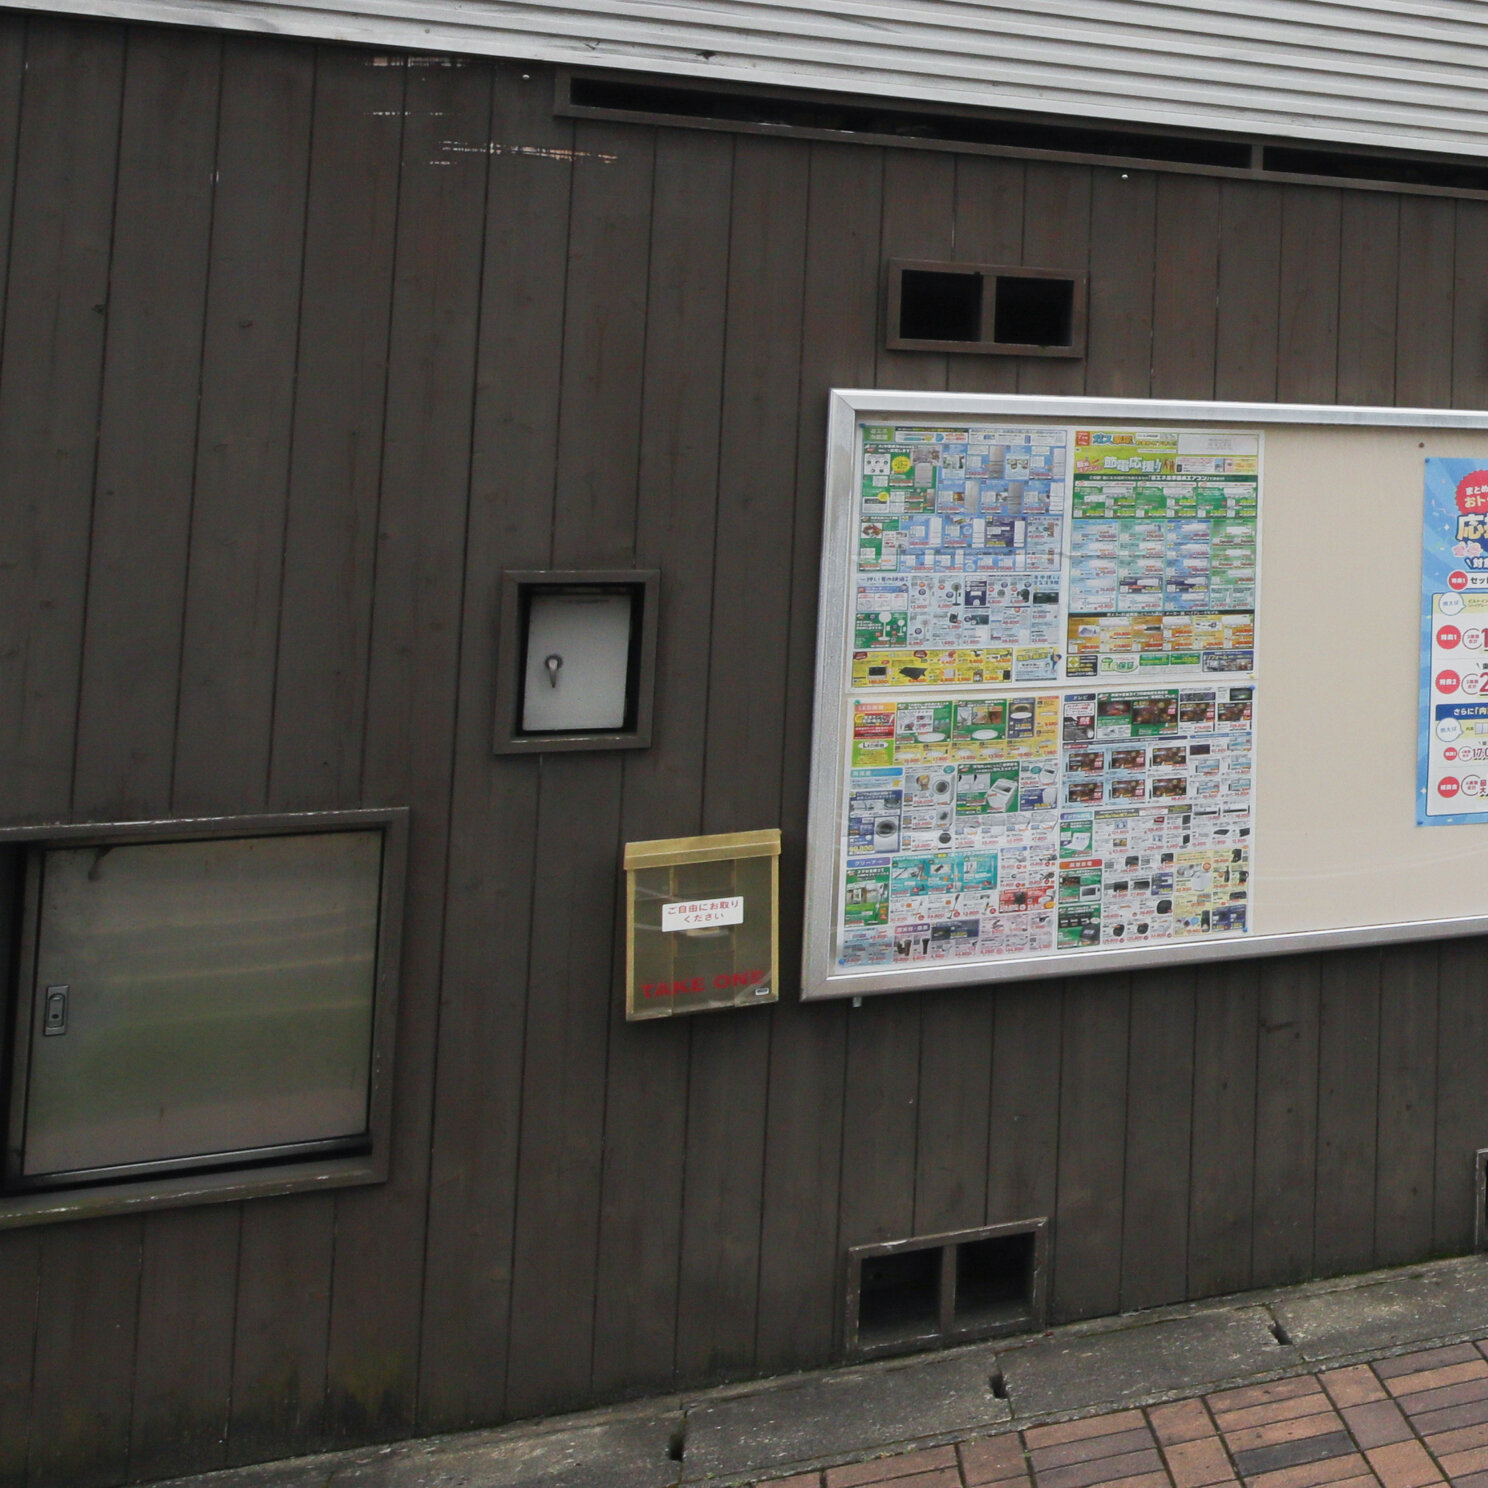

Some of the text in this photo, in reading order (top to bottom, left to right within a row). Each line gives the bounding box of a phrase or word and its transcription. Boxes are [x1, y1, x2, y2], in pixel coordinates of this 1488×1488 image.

[667, 900, 739, 915] ご自由にお取り
[684, 912, 725, 923] ください
[640, 969, 765, 999] TAKE ONE
